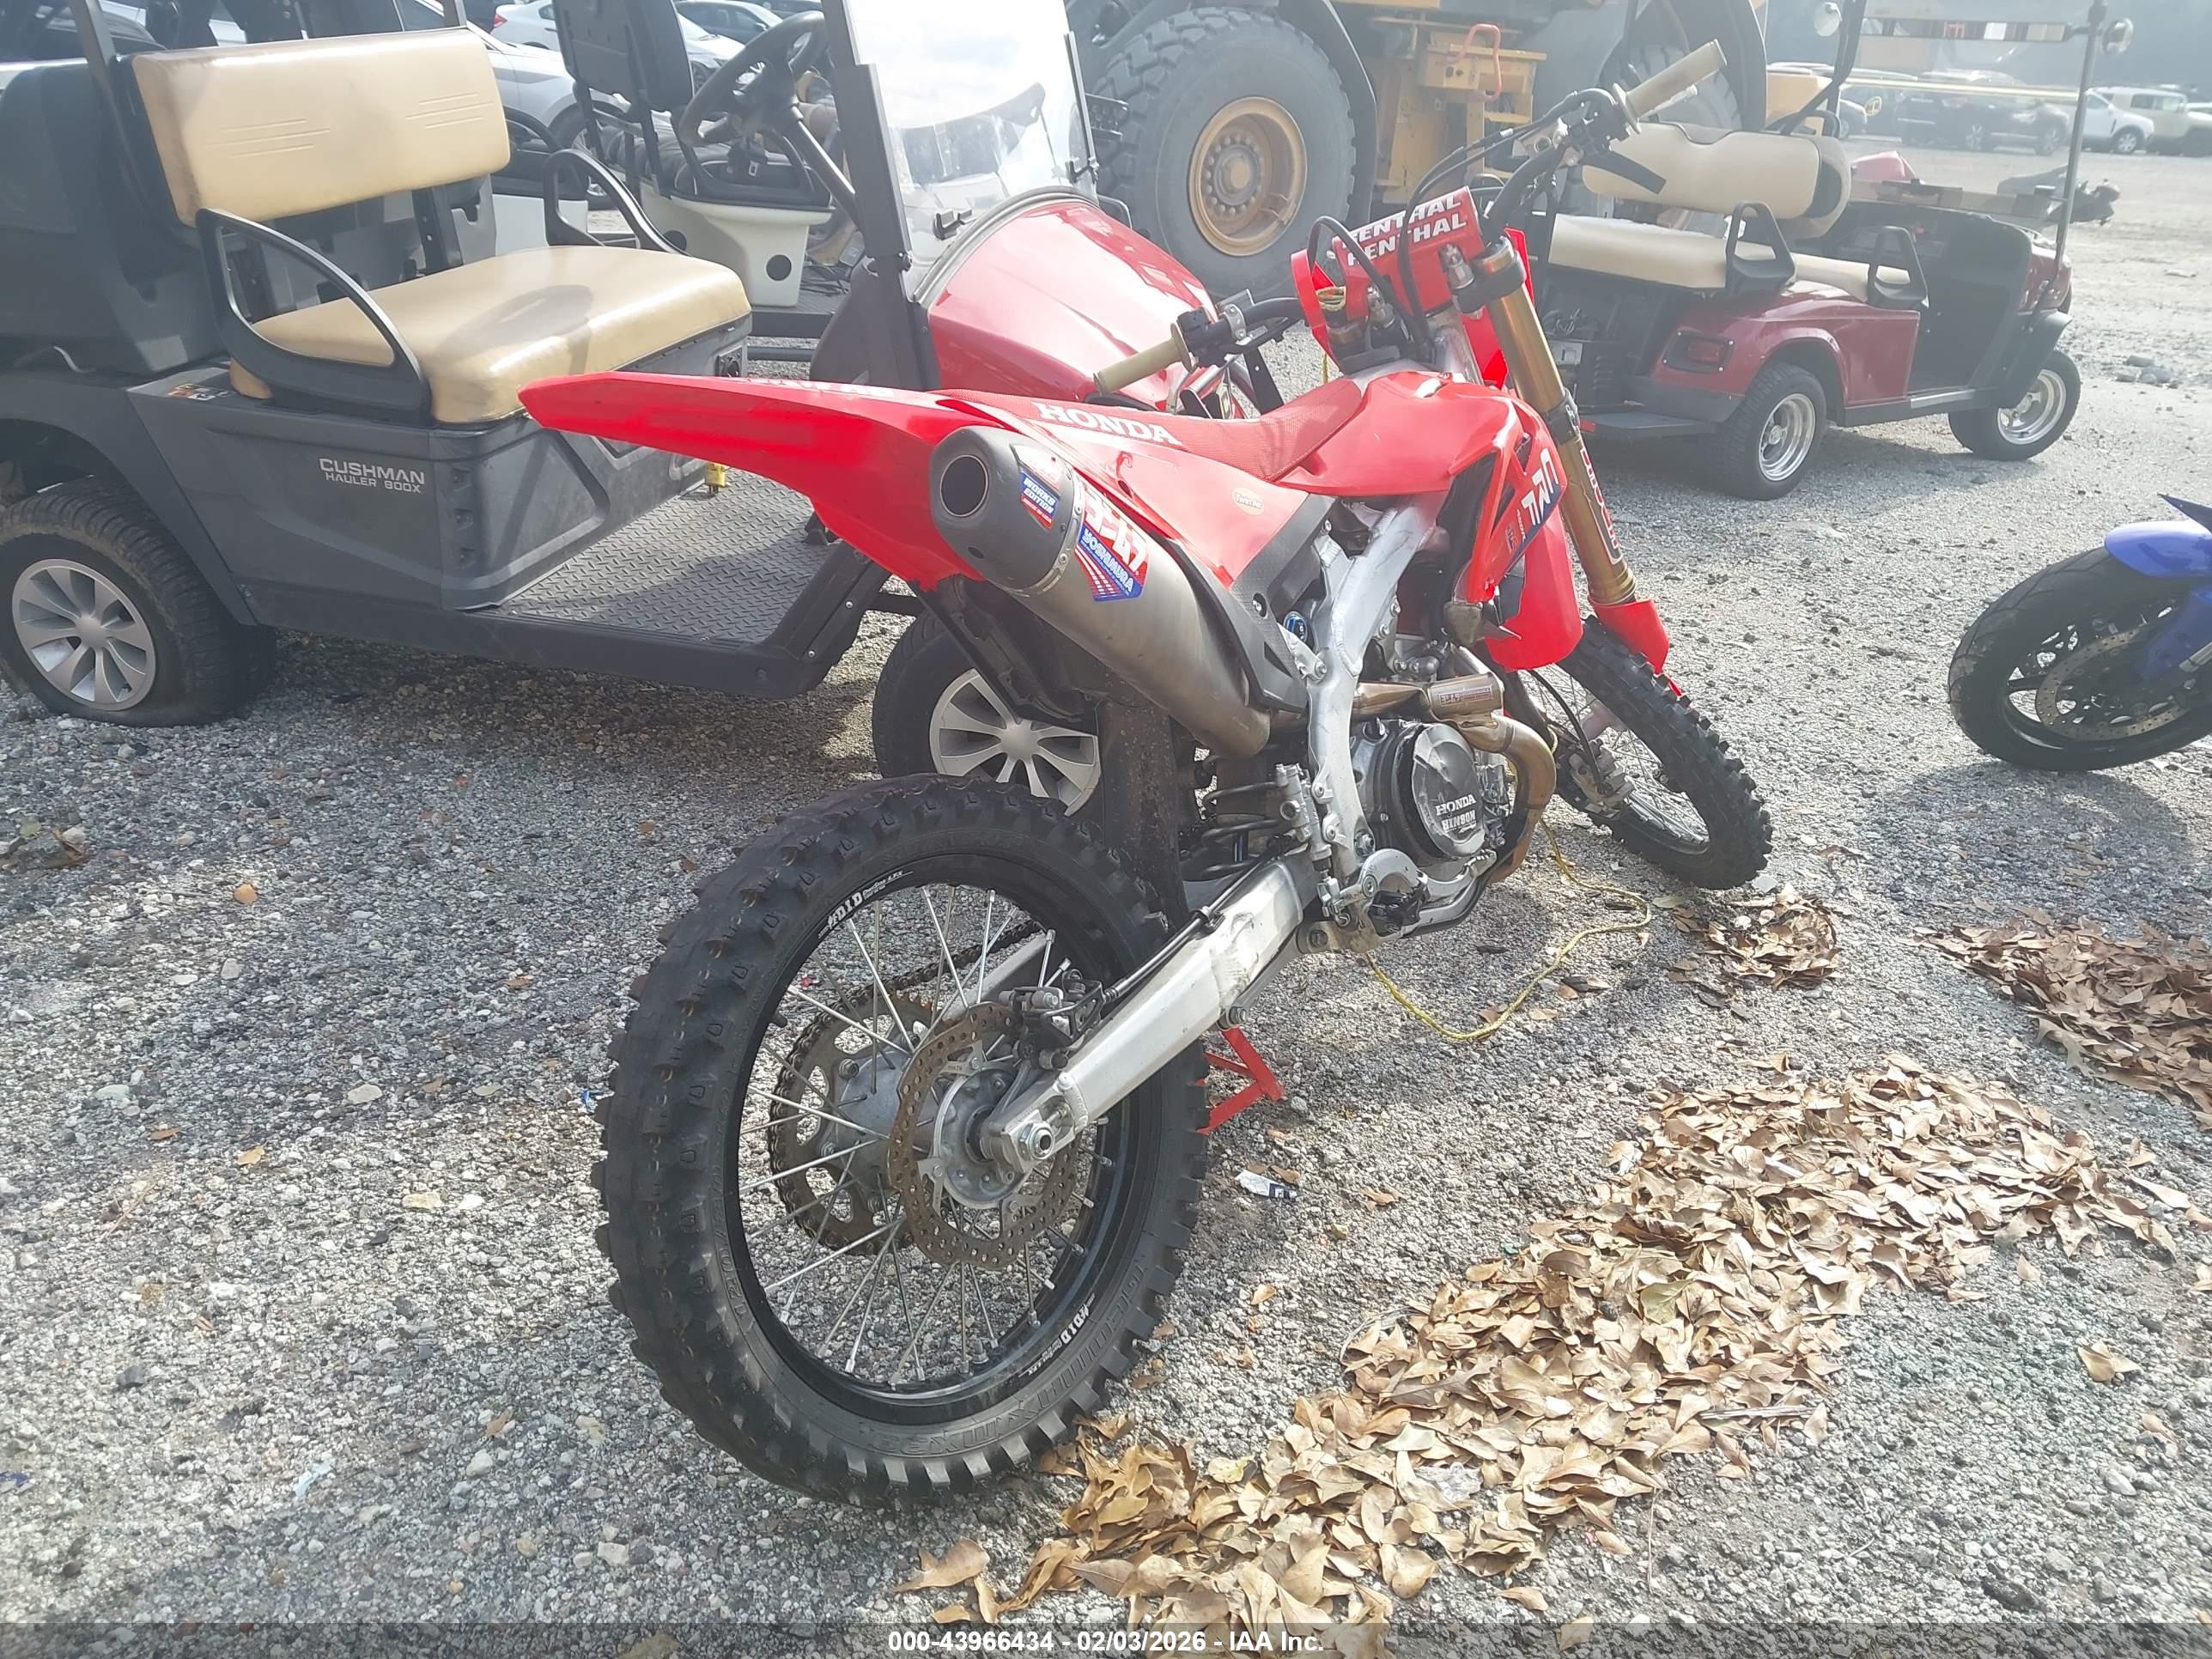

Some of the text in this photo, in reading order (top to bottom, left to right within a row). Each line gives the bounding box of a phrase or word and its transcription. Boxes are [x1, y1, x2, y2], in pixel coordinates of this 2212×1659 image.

[1030, 402, 1183, 446] HONDA
[319, 458, 425, 484] CUSHMAN
[325, 471, 377, 488] HAULER
[1023, 476, 1056, 507] WORKS
[1023, 487, 1054, 514] EDITION
[1521, 447, 1559, 526] CRF
[1081, 527, 1134, 593] YOSHIMURA
[1435, 793, 1477, 817] HONDA
